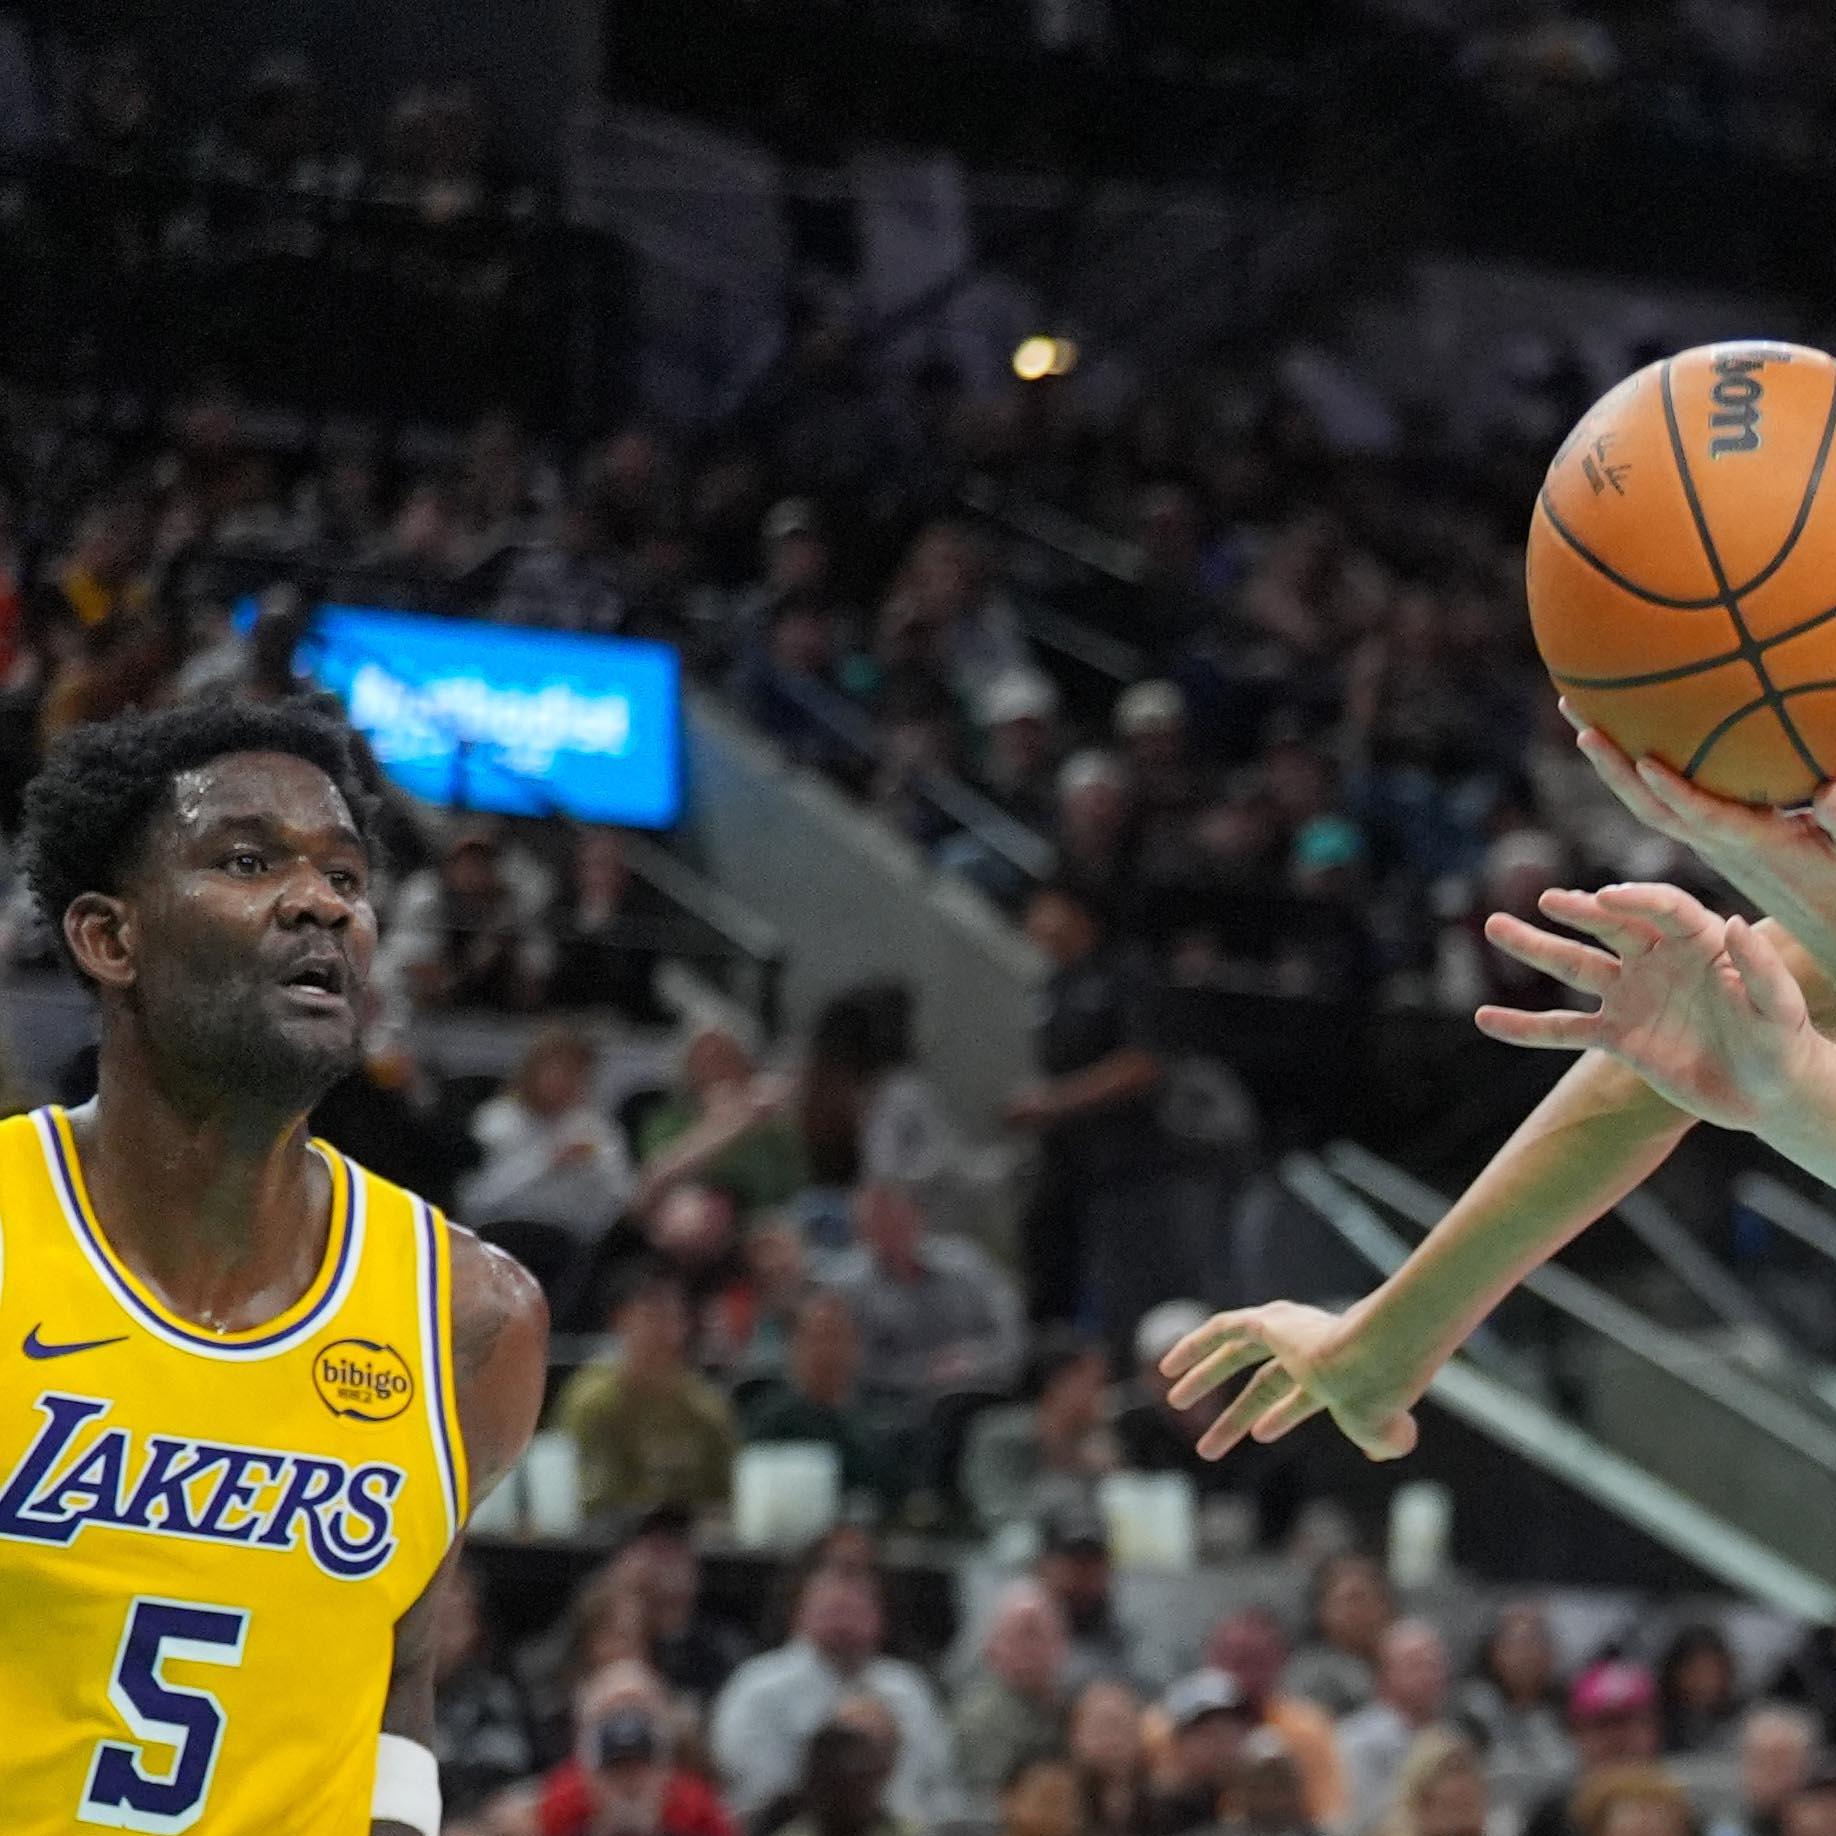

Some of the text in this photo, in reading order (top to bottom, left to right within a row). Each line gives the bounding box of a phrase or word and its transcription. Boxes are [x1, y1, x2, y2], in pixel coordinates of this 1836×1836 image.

[322, 1359, 408, 1400] bibigo
[0, 1391, 407, 1581] LAKERS
[76, 1595, 252, 1834] 5
